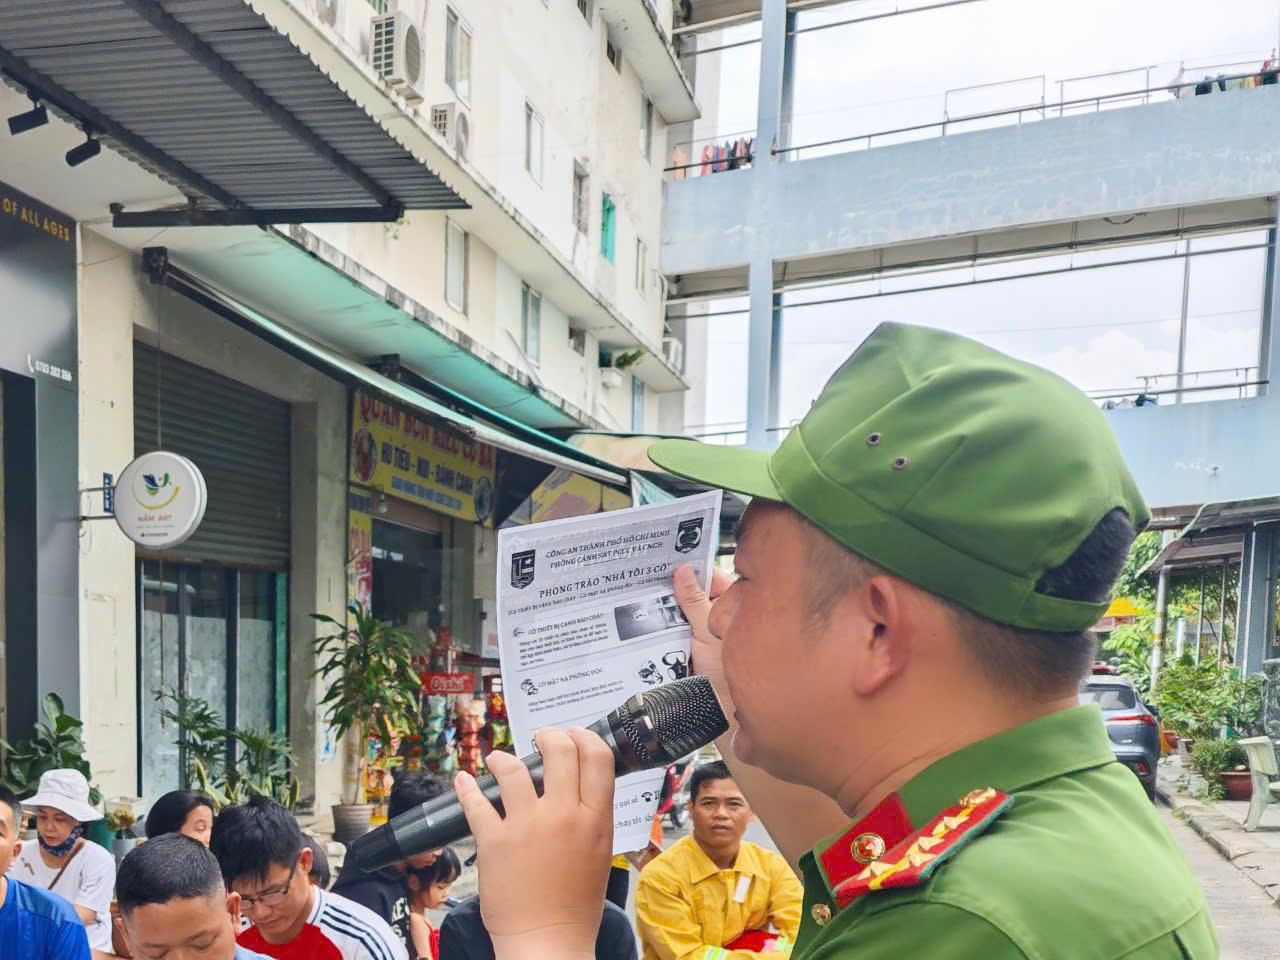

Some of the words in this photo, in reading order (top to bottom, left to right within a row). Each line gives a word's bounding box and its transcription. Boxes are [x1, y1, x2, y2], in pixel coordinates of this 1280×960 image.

[3, 197, 18, 216] OF
[21, 207, 41, 228] ALL
[43, 217, 70, 241] AGES
[579, 541, 606, 553] THÀNH
[650, 529, 671, 538] MINH
[550, 558, 577, 569] PHÒNG
[540, 583, 573, 599] PHONG
[574, 576, 600, 591] TRÀO
[628, 566, 645, 578] TÔI
[646, 566, 652, 575] 3
[431, 675, 466, 691] Oishi
